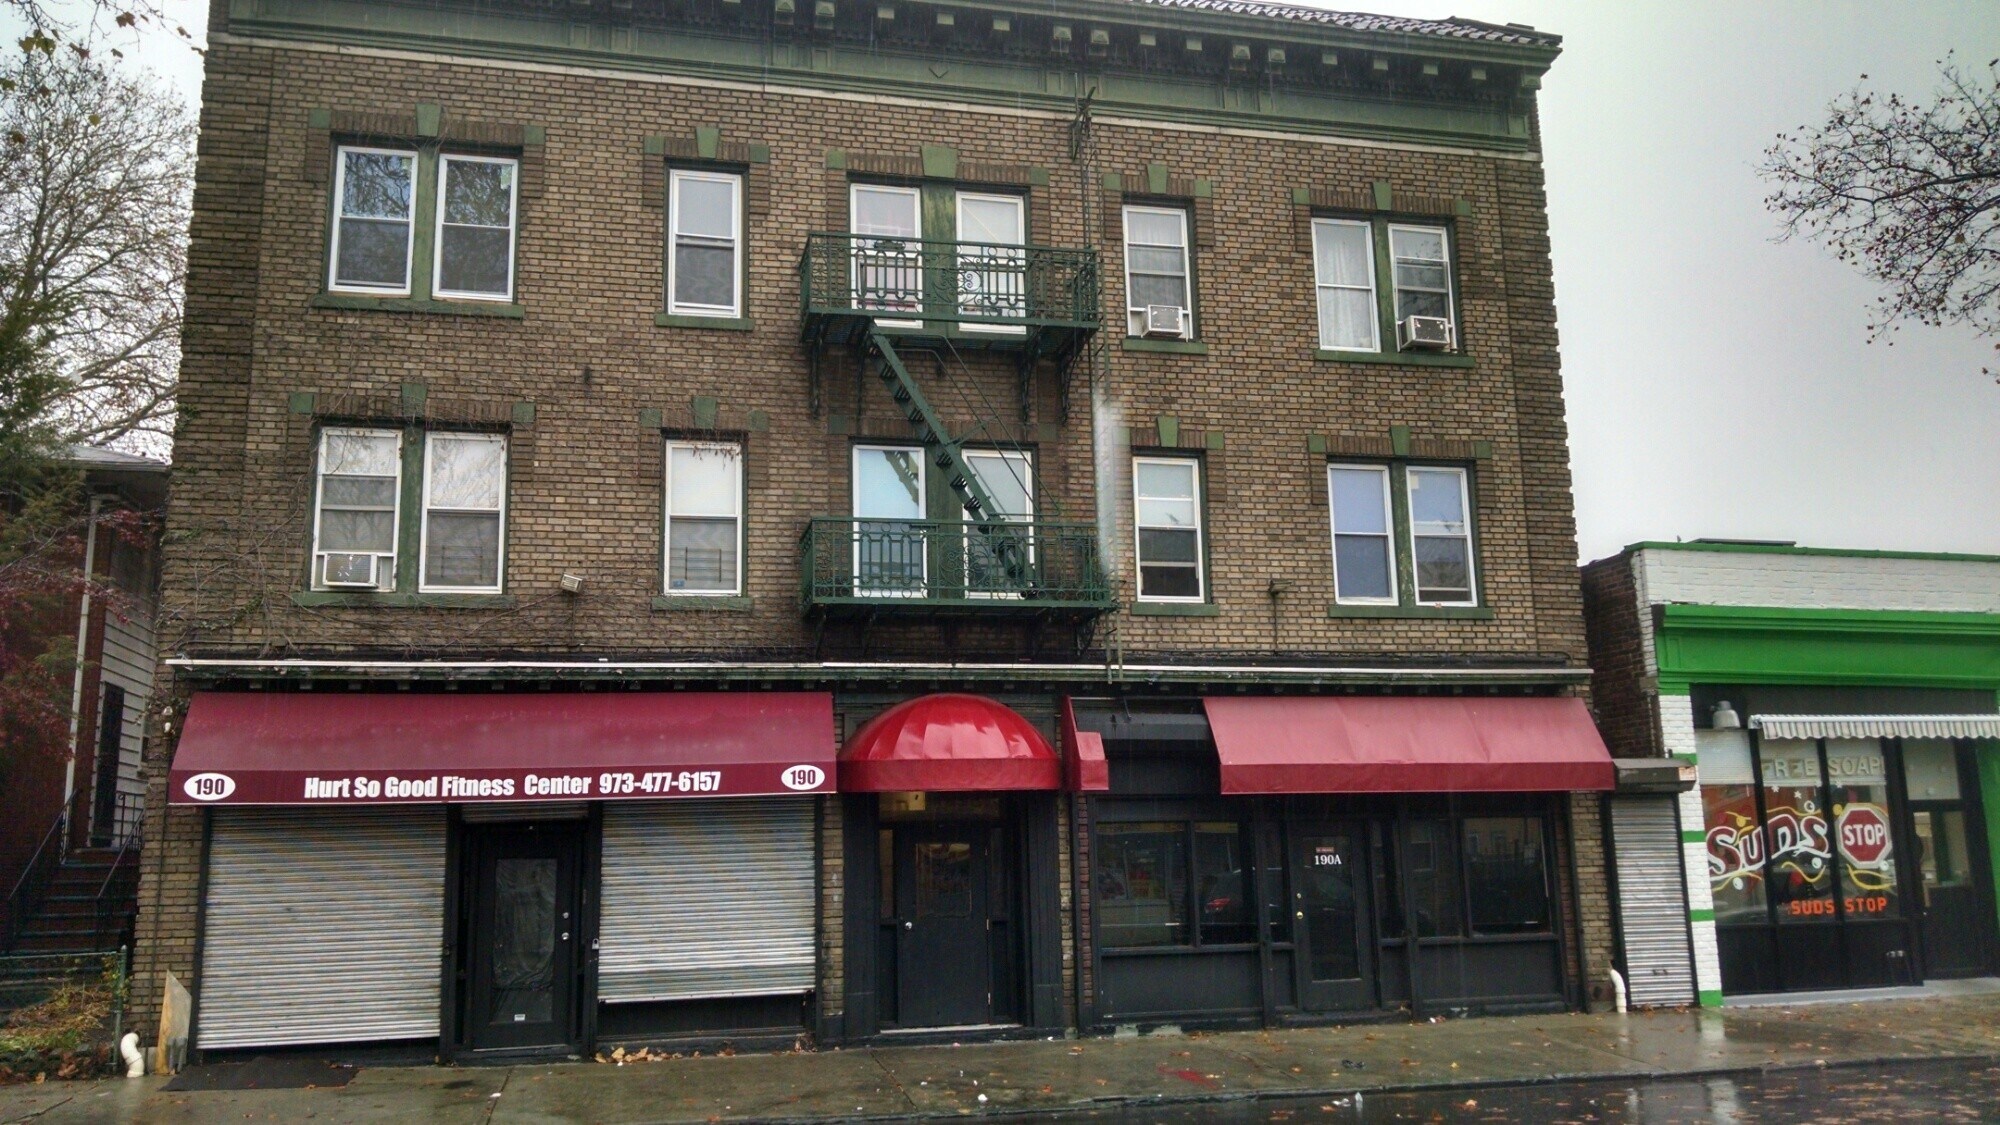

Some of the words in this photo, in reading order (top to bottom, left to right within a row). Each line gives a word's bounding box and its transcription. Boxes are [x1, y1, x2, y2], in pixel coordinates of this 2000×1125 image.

[790, 769, 816, 786] 190
[1760, 758, 1818, 778] FREE
[194, 778, 225, 795] 190
[304, 777, 350, 799] Hurt
[354, 777, 381, 798] So
[384, 776, 437, 798] Good
[441, 775, 515, 797] Fitness
[524, 774, 591, 795] Center
[599, 771, 721, 794] 973-477-6157
[1843, 823, 1885, 846] STOP
[1314, 854, 1342, 865] 190A
[1790, 899, 1835, 916] SUDS
[1844, 897, 1887, 913] STOP
